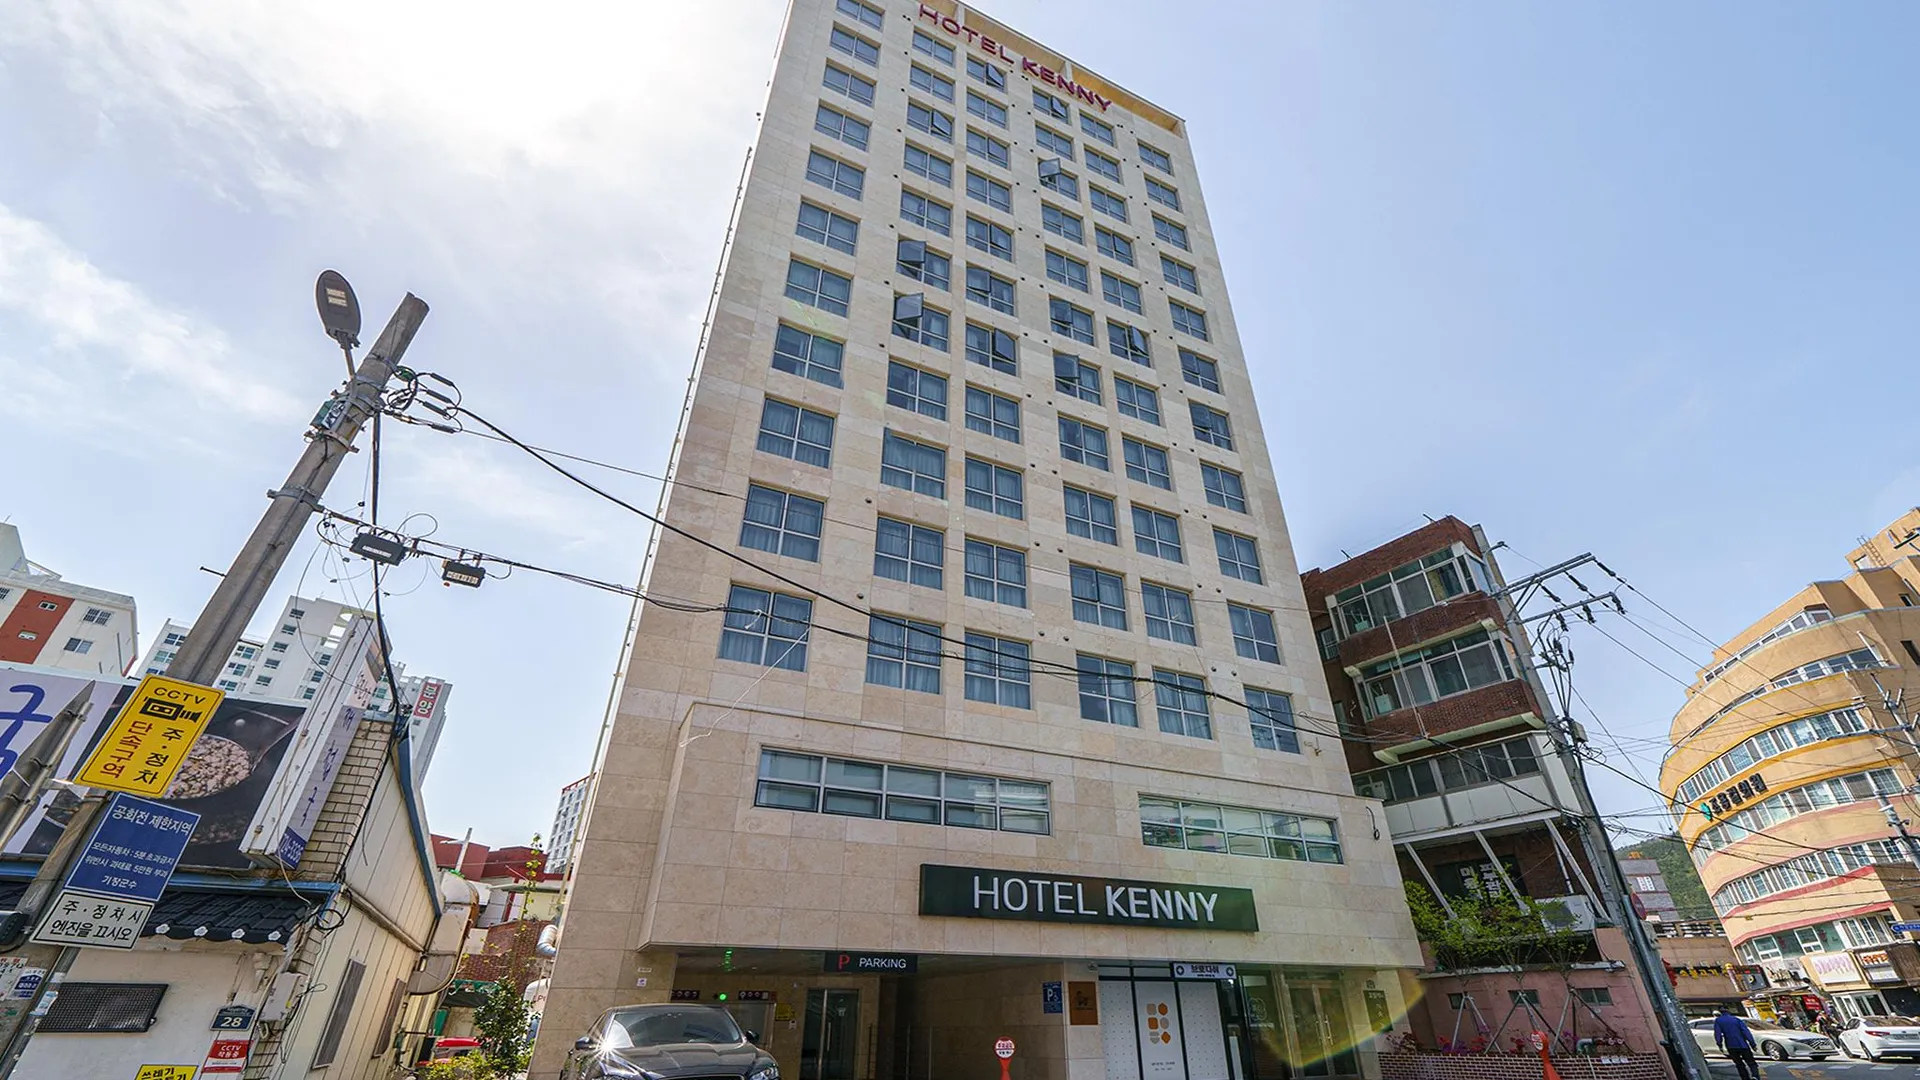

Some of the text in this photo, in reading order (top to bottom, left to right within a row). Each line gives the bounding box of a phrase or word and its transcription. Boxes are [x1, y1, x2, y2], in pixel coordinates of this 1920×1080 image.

[919, 3, 1112, 112] HOTEL KENNY
[154, 687, 206, 704] CCTV
[100, 720, 153, 778] 단속구역
[112, 804, 193, 836] 공회전 제한지역
[85, 855, 168, 878] 위반시 과태료 5만원 부과
[102, 875, 137, 889] 기장군수
[974, 876, 1218, 922] HOTEL KENNY
[49, 919, 132, 941] 엔진을 끄시오
[839, 954, 907, 969] P PARKING
[220, 1016, 243, 1027] 28
[141, 1067, 175, 1079] 쓰레기
